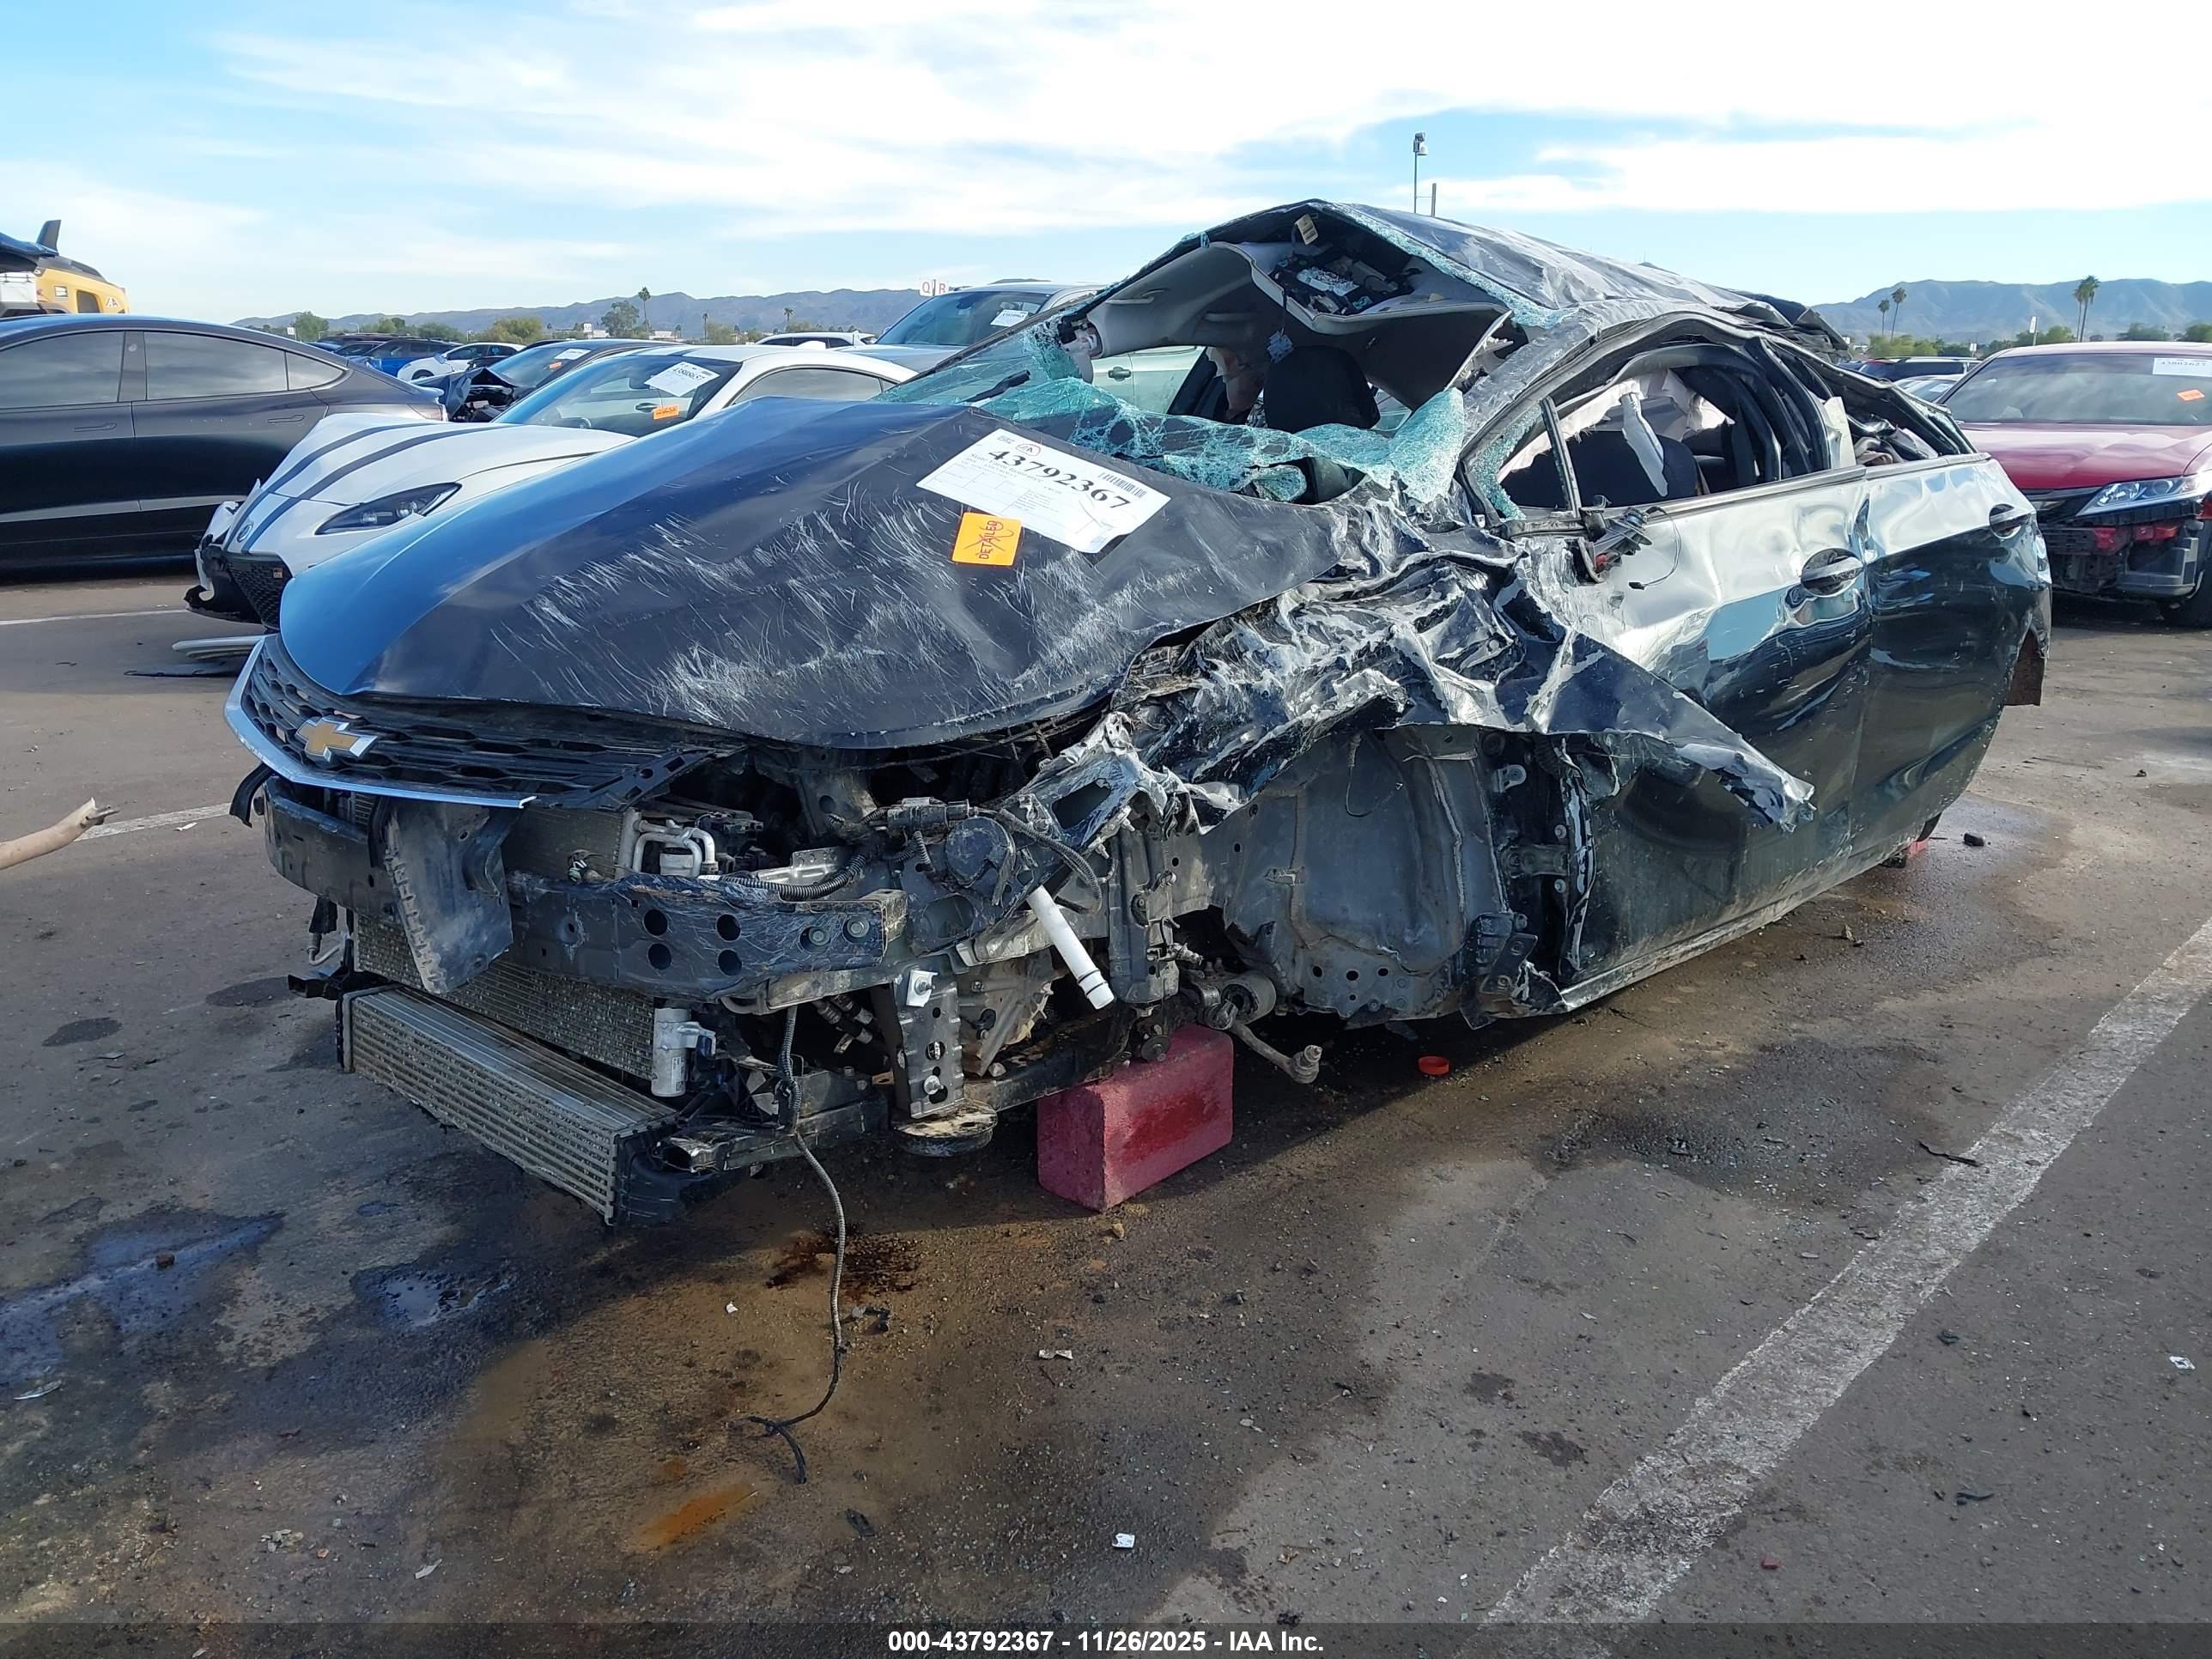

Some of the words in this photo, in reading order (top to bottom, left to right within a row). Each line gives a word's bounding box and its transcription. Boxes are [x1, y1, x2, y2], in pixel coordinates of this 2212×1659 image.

[921, 281, 931, 294] Q
[939, 282, 946, 295] R
[988, 449, 1132, 509] 43792367
[978, 520, 998, 560] DETAILED
